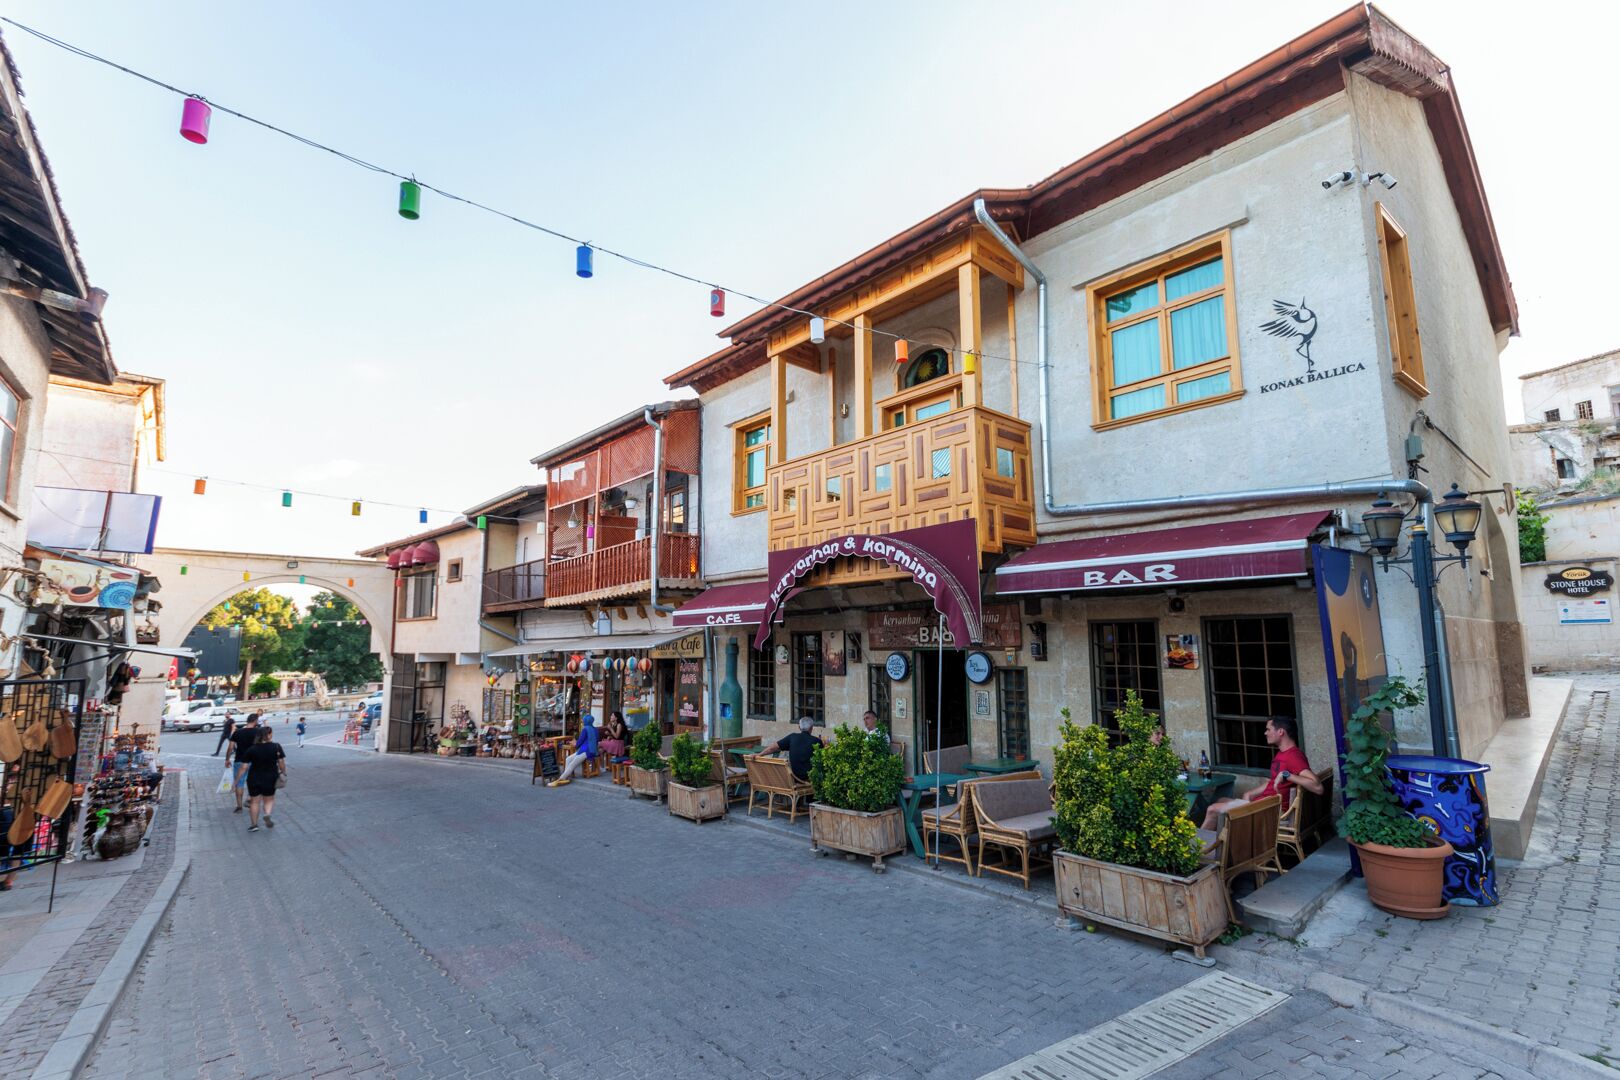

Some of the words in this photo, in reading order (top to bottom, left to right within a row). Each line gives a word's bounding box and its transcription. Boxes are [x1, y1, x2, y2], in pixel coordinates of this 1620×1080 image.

[1260, 376, 1304, 394] KONAK
[1307, 362, 1366, 383] BALLICA
[843, 536, 856, 550] &
[1083, 563, 1179, 586] BAR
[1550, 580, 1577, 589] STONE
[1577, 578, 1607, 588] HOUSE
[1567, 586, 1590, 594] HOTEL
[706, 613, 742, 625] CAFE
